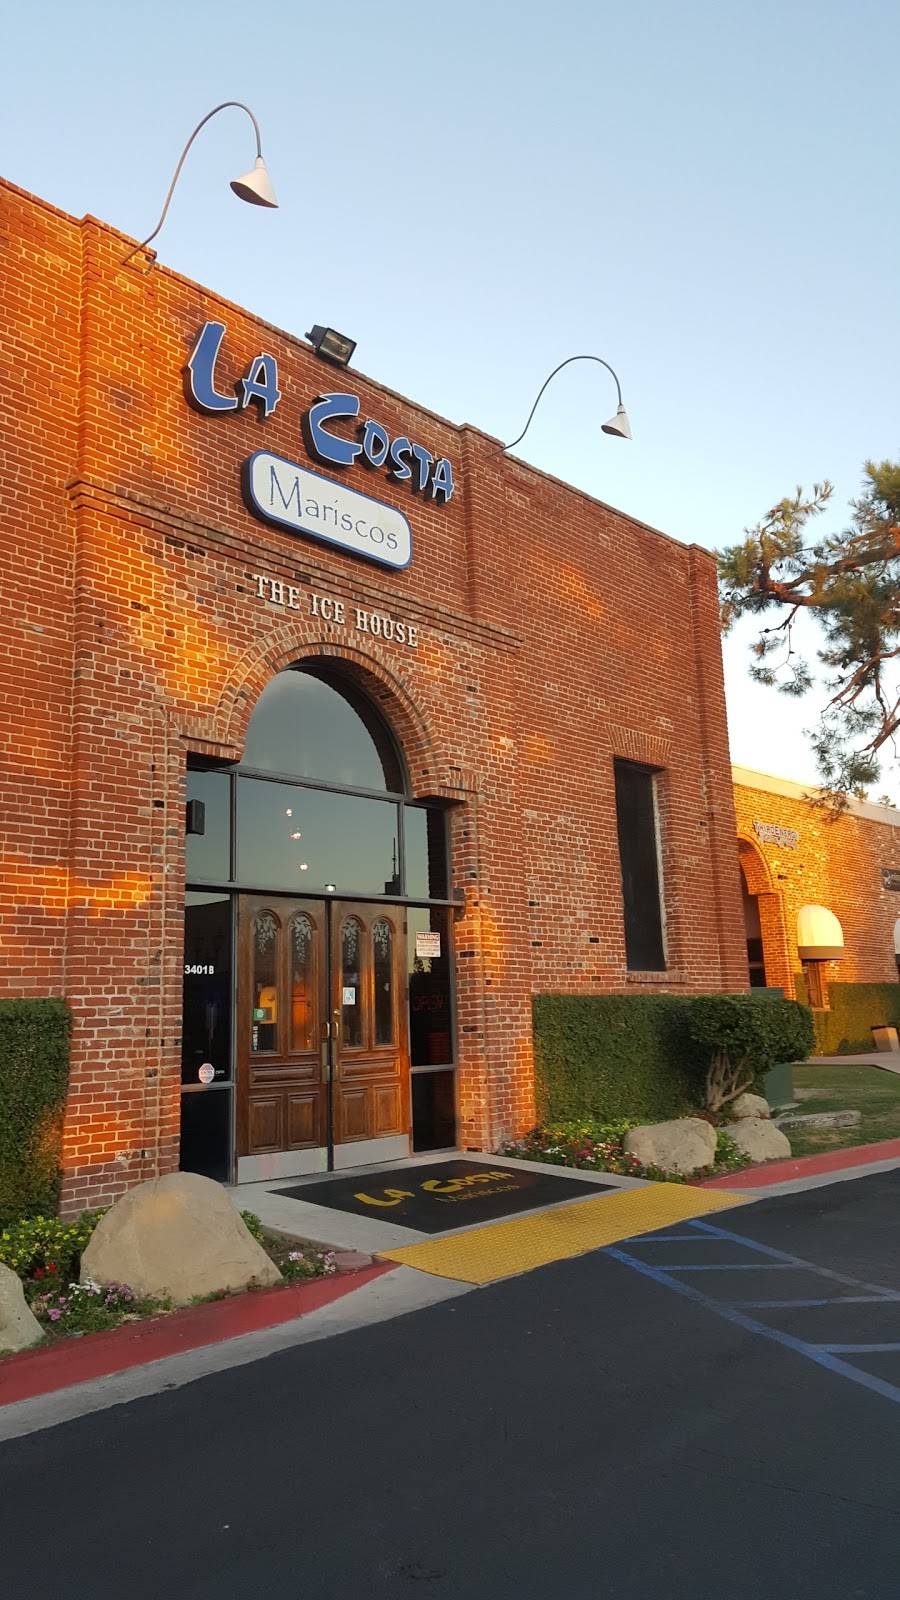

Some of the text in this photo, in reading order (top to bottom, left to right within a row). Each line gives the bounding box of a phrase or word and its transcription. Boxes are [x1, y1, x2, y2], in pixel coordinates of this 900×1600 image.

[187, 320, 455, 503] LA COSTA
[269, 464, 399, 551] Mariscos
[253, 574, 419, 648] THE ICE HOUSE
[184, 964, 215, 975] 3401B
[353, 1188, 415, 1207] LA
